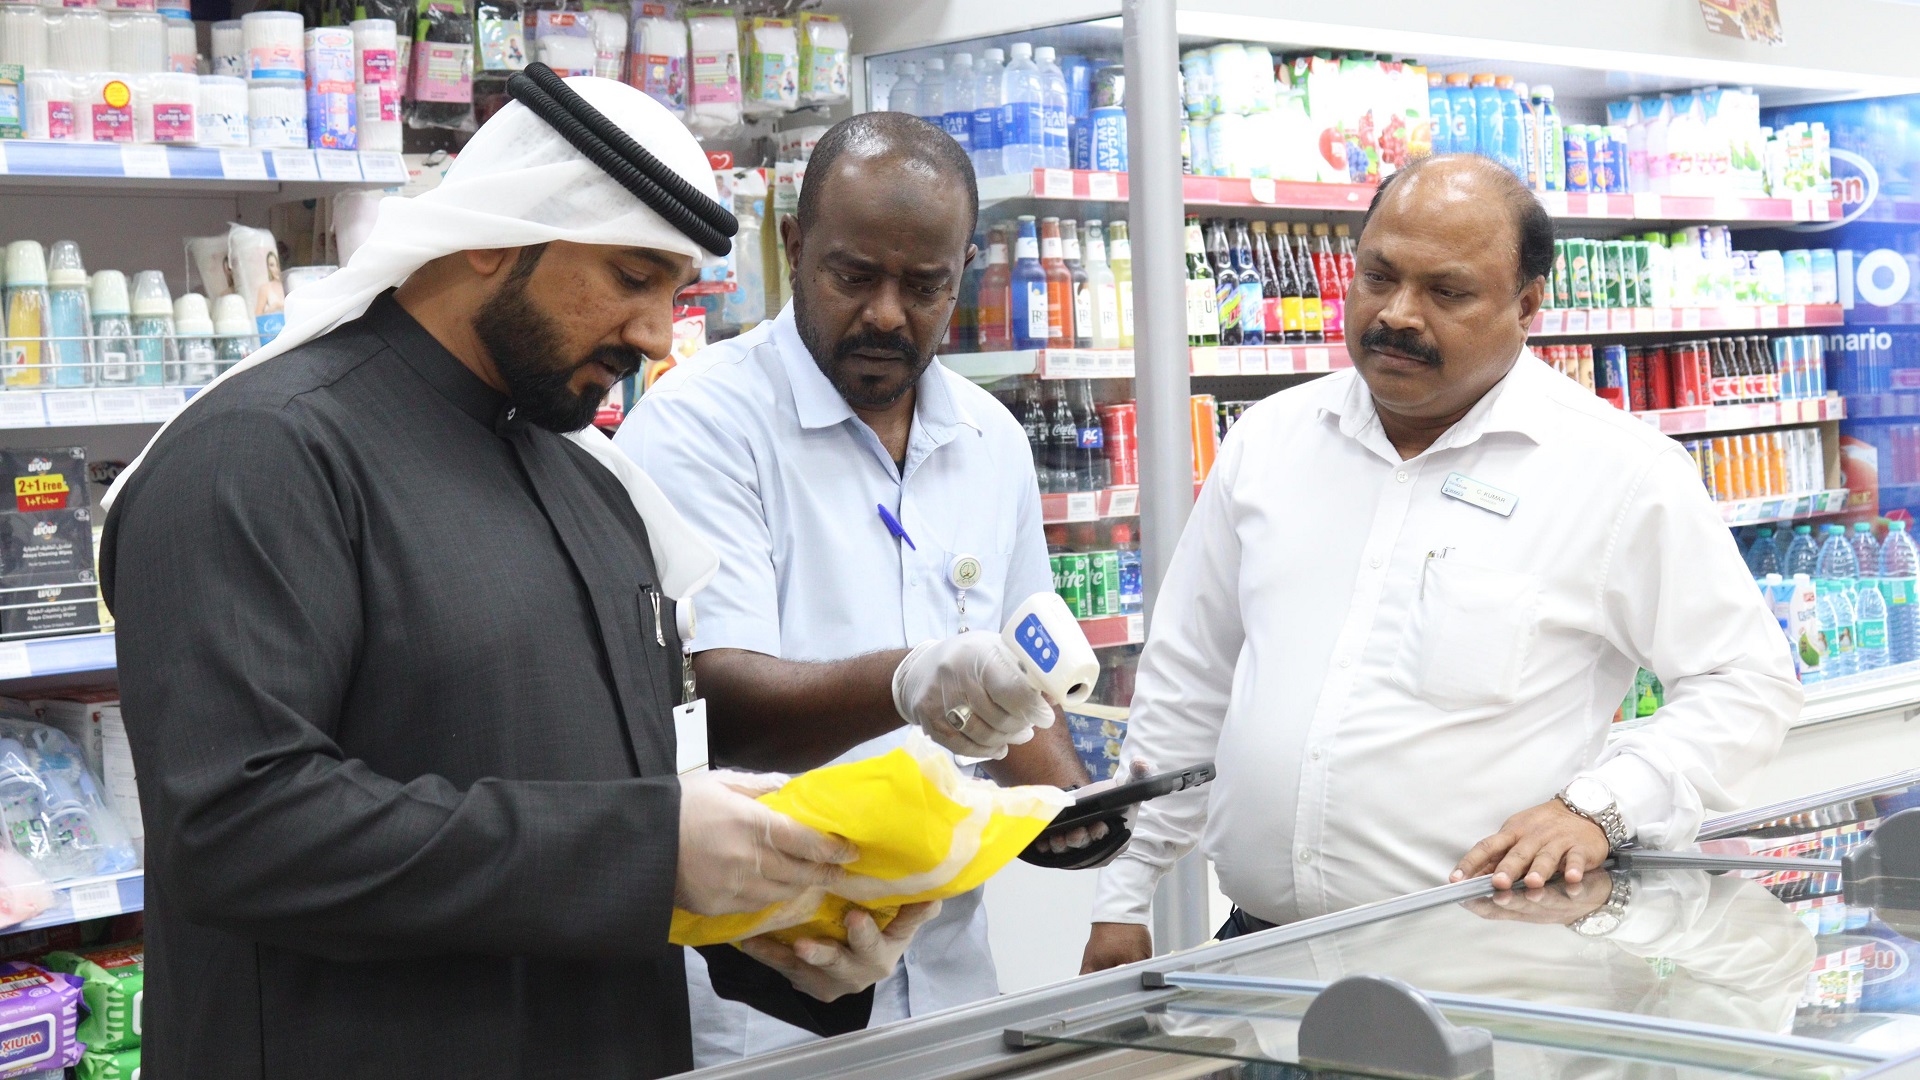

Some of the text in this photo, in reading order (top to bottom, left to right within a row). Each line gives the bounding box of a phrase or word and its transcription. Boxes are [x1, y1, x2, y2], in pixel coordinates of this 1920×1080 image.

[1097, 118, 1110, 168] SWEAT
[1083, 429, 1098, 443] RC
[18, 479, 62, 493] 2+1 Free
[1483, 491, 1506, 503] KUMAR
